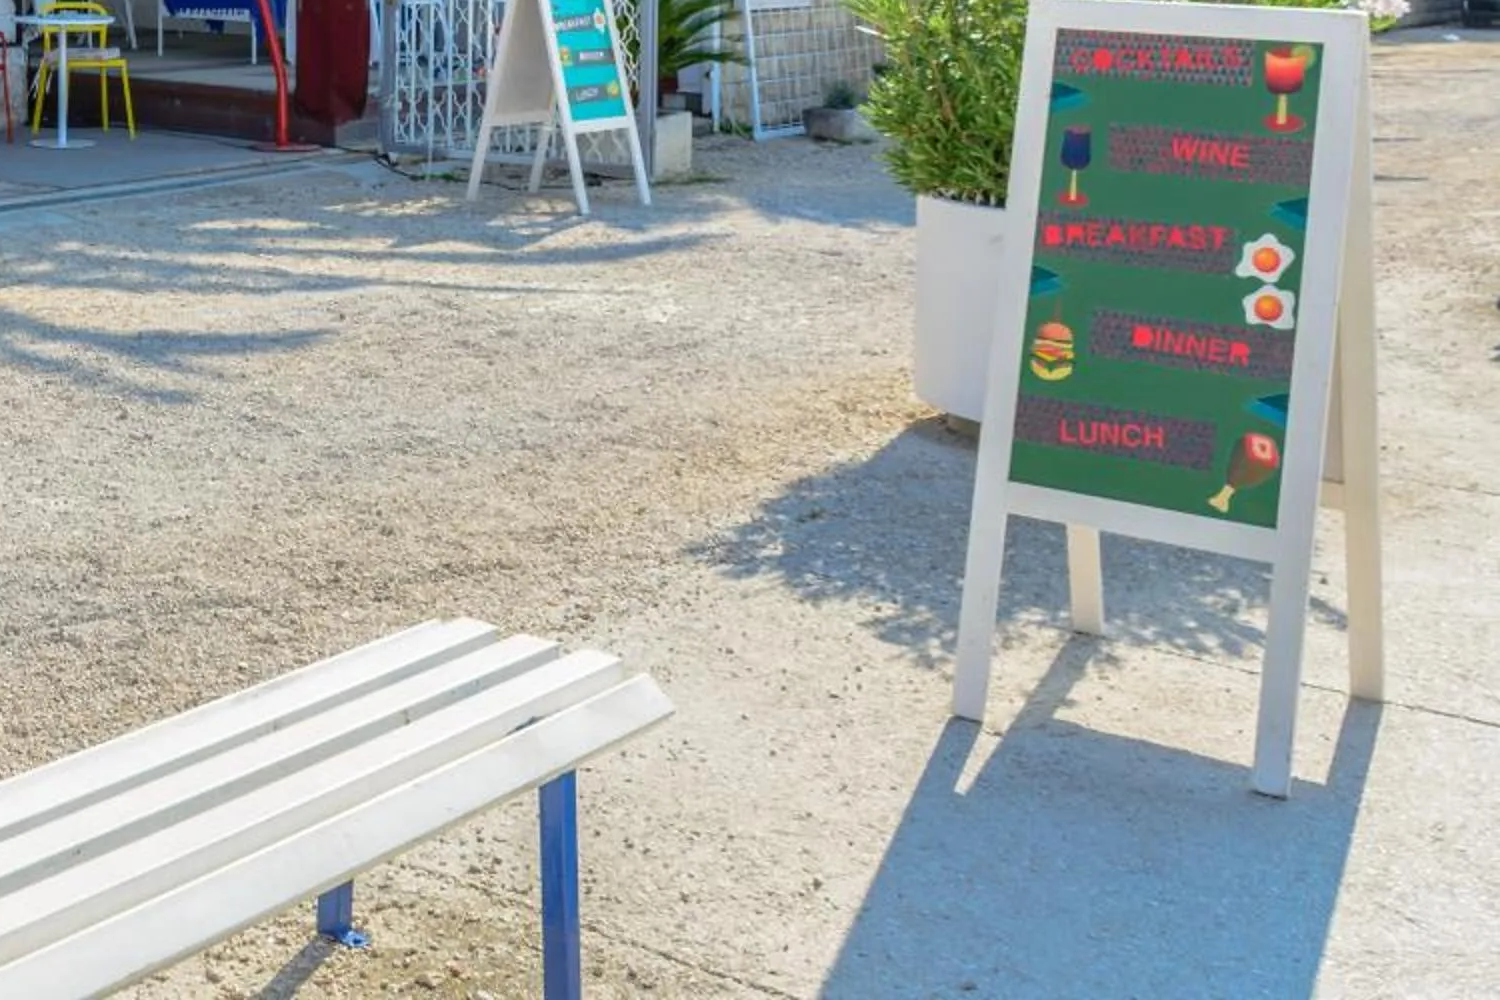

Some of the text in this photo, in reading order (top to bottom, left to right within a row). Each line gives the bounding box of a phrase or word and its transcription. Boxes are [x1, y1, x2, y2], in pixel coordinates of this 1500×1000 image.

[1172, 134, 1249, 168] WINE
[1043, 223, 1227, 249] BREAKFAST
[1132, 325, 1251, 366] DINNER
[1058, 419, 1165, 448] LUNCH
